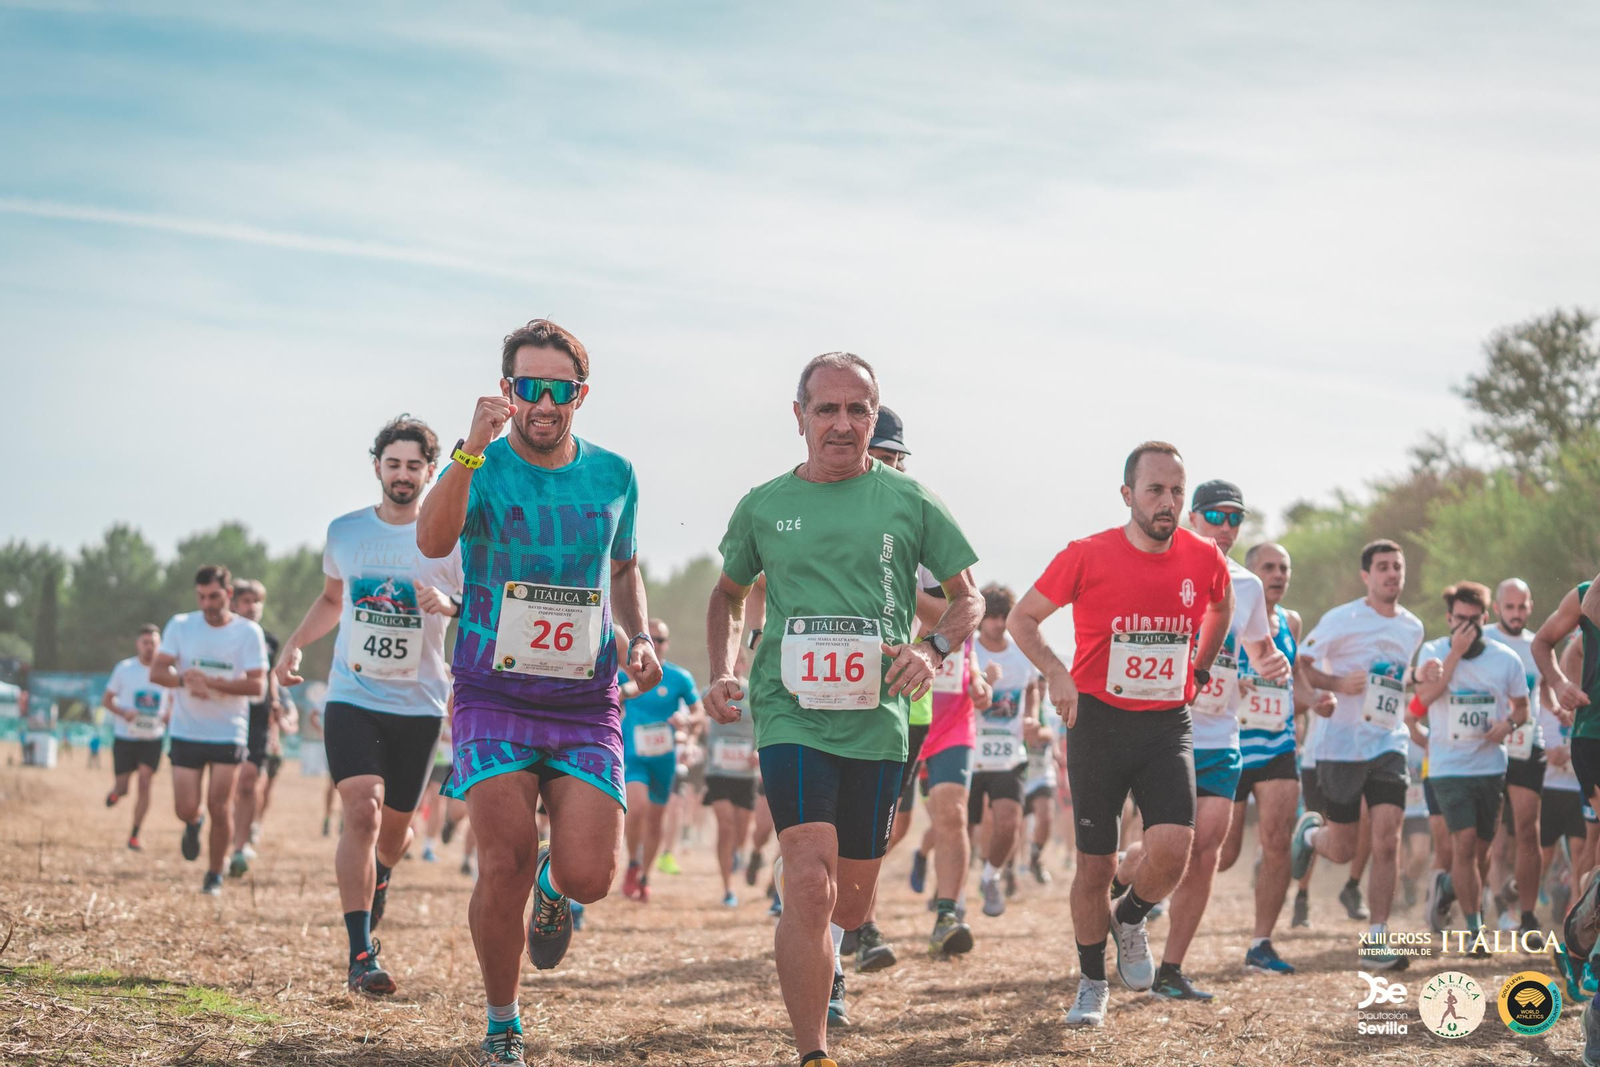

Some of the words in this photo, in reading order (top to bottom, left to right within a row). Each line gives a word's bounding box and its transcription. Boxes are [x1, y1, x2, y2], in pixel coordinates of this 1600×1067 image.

[776, 516, 802, 531] OZÉ
[880, 533, 894, 563] Team
[533, 588, 580, 603] ITÁLICA
[880, 567, 896, 617] Running
[372, 613, 405, 626] ITÁLICA
[811, 618, 857, 632] ITÁLICA
[530, 619, 574, 652] 26
[1135, 632, 1170, 643] ITÁLICA
[363, 635, 408, 660] 485
[801, 651, 865, 683] 116
[1125, 656, 1174, 680] 824
[1249, 695, 1282, 716] 511
[981, 742, 1013, 757] 828
